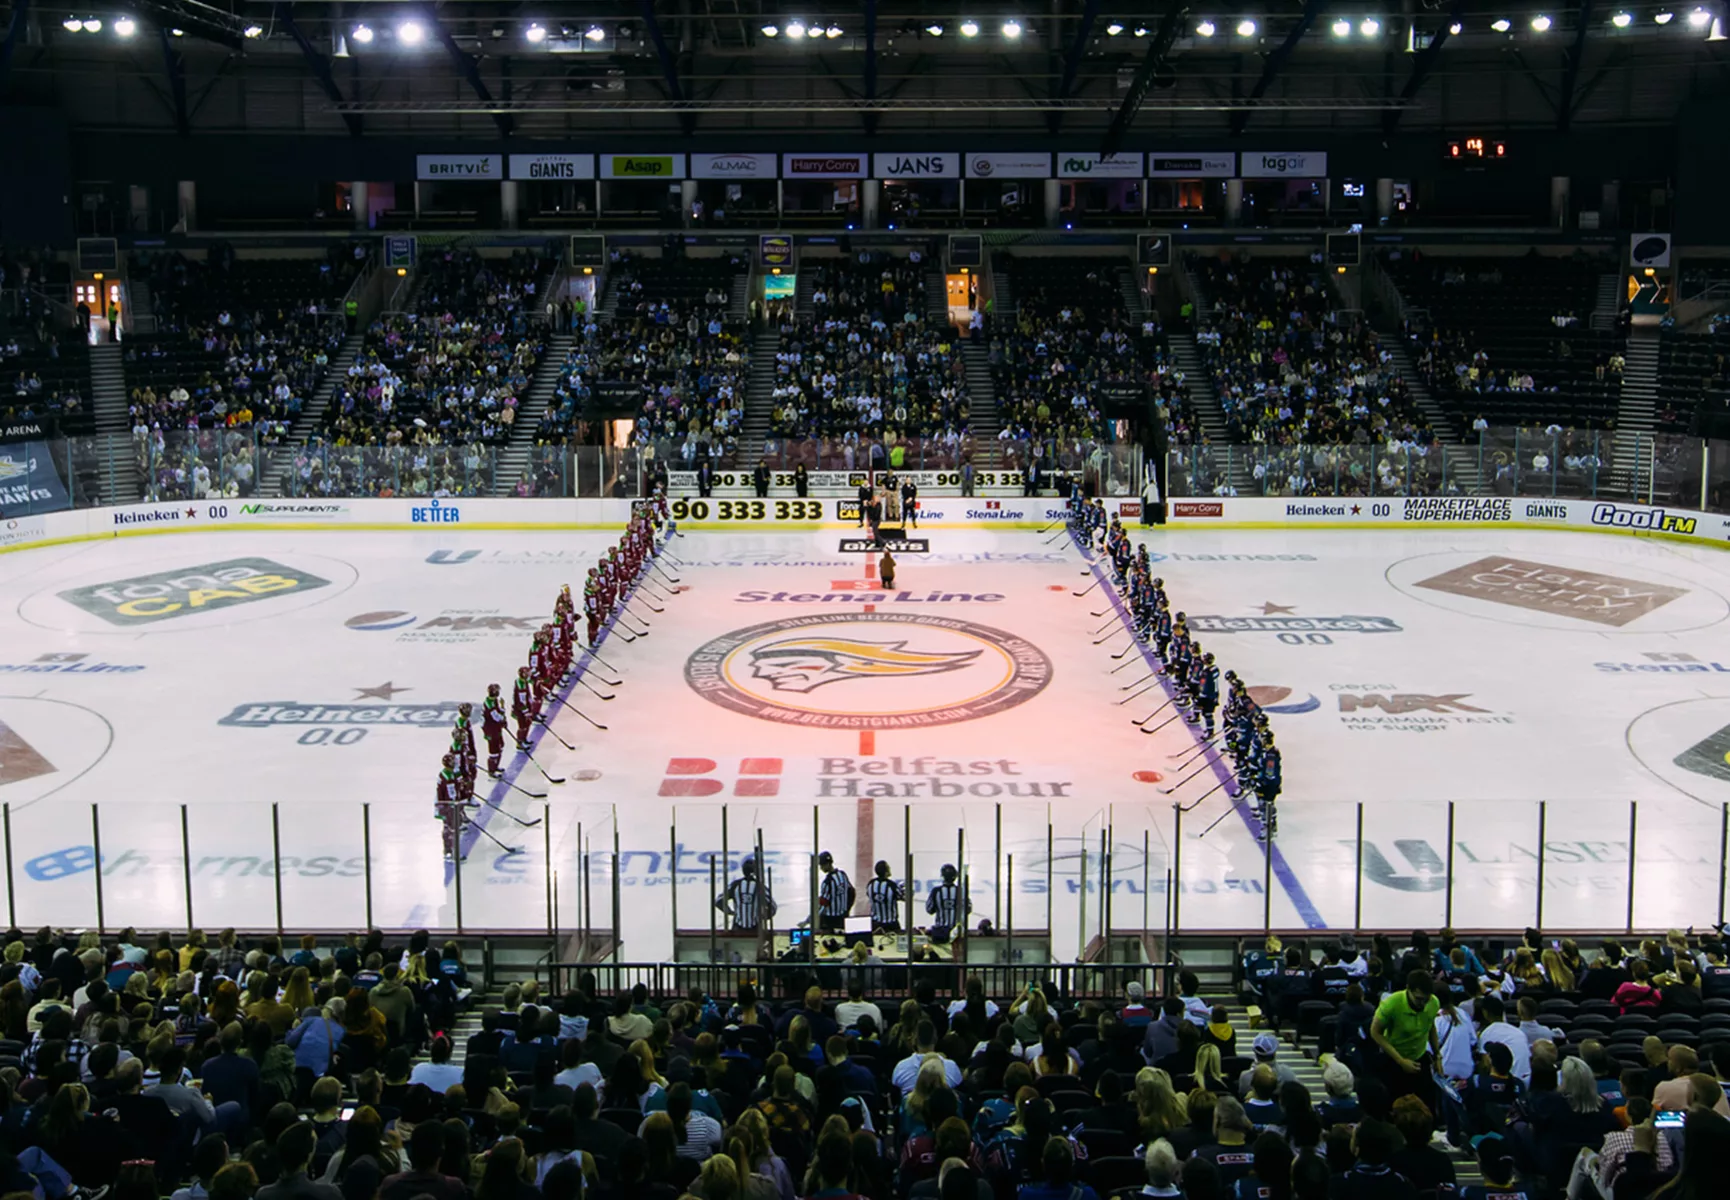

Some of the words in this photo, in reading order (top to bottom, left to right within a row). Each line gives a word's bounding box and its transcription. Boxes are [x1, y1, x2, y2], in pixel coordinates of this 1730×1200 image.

[429, 163, 490, 173] BRITVIC
[530, 163, 574, 177] GIANTS
[624, 159, 662, 173] Asap
[711, 161, 757, 171] ALMAC
[793, 160, 823, 172] Harry
[825, 160, 857, 171] Corry
[888, 157, 943, 174] JANS
[6, 425, 41, 436] ARENA
[776, 474, 796, 486] 33
[937, 474, 959, 486] 90
[672, 502, 709, 520] 90
[718, 502, 766, 520] 333
[775, 502, 823, 520] 333
[1176, 504, 1198, 513] Harry
[1199, 504, 1221, 513] Corry
[1286, 504, 1345, 515] Heineken
[1405, 499, 1511, 510] MARKETPLACE
[1526, 504, 1567, 518] GIANTS
[114, 509, 179, 524] Heineken
[412, 508, 459, 523] BETTER
[840, 509, 860, 519] CAB
[920, 510, 944, 519] Line
[966, 509, 998, 519] Stena
[999, 509, 1024, 519] Line
[1403, 510, 1512, 521] SUPERHEROES
[1170, 553, 1317, 562] harness
[91, 566, 264, 602] fona
[1493, 563, 1655, 599] Harry
[117, 574, 298, 616] CAB
[734, 590, 894, 602] Stena
[892, 590, 1006, 602] Line
[1472, 572, 1636, 609] Corry
[857, 614, 914, 622] BELFAST
[915, 616, 966, 628] GIANTS
[1191, 615, 1392, 632] Heineken
[61, 662, 146, 674] Line
[1593, 662, 1711, 673] Stena
[1338, 693, 1495, 713] MAX
[237, 706, 463, 722] Heineken
[1340, 717, 1449, 725] MAXIMUM
[1382, 725, 1448, 733] sugar
[297, 728, 369, 746] 0.0
[818, 756, 1022, 776] Belfast
[814, 777, 1072, 798] Harbour
[102, 849, 379, 877] hrness
